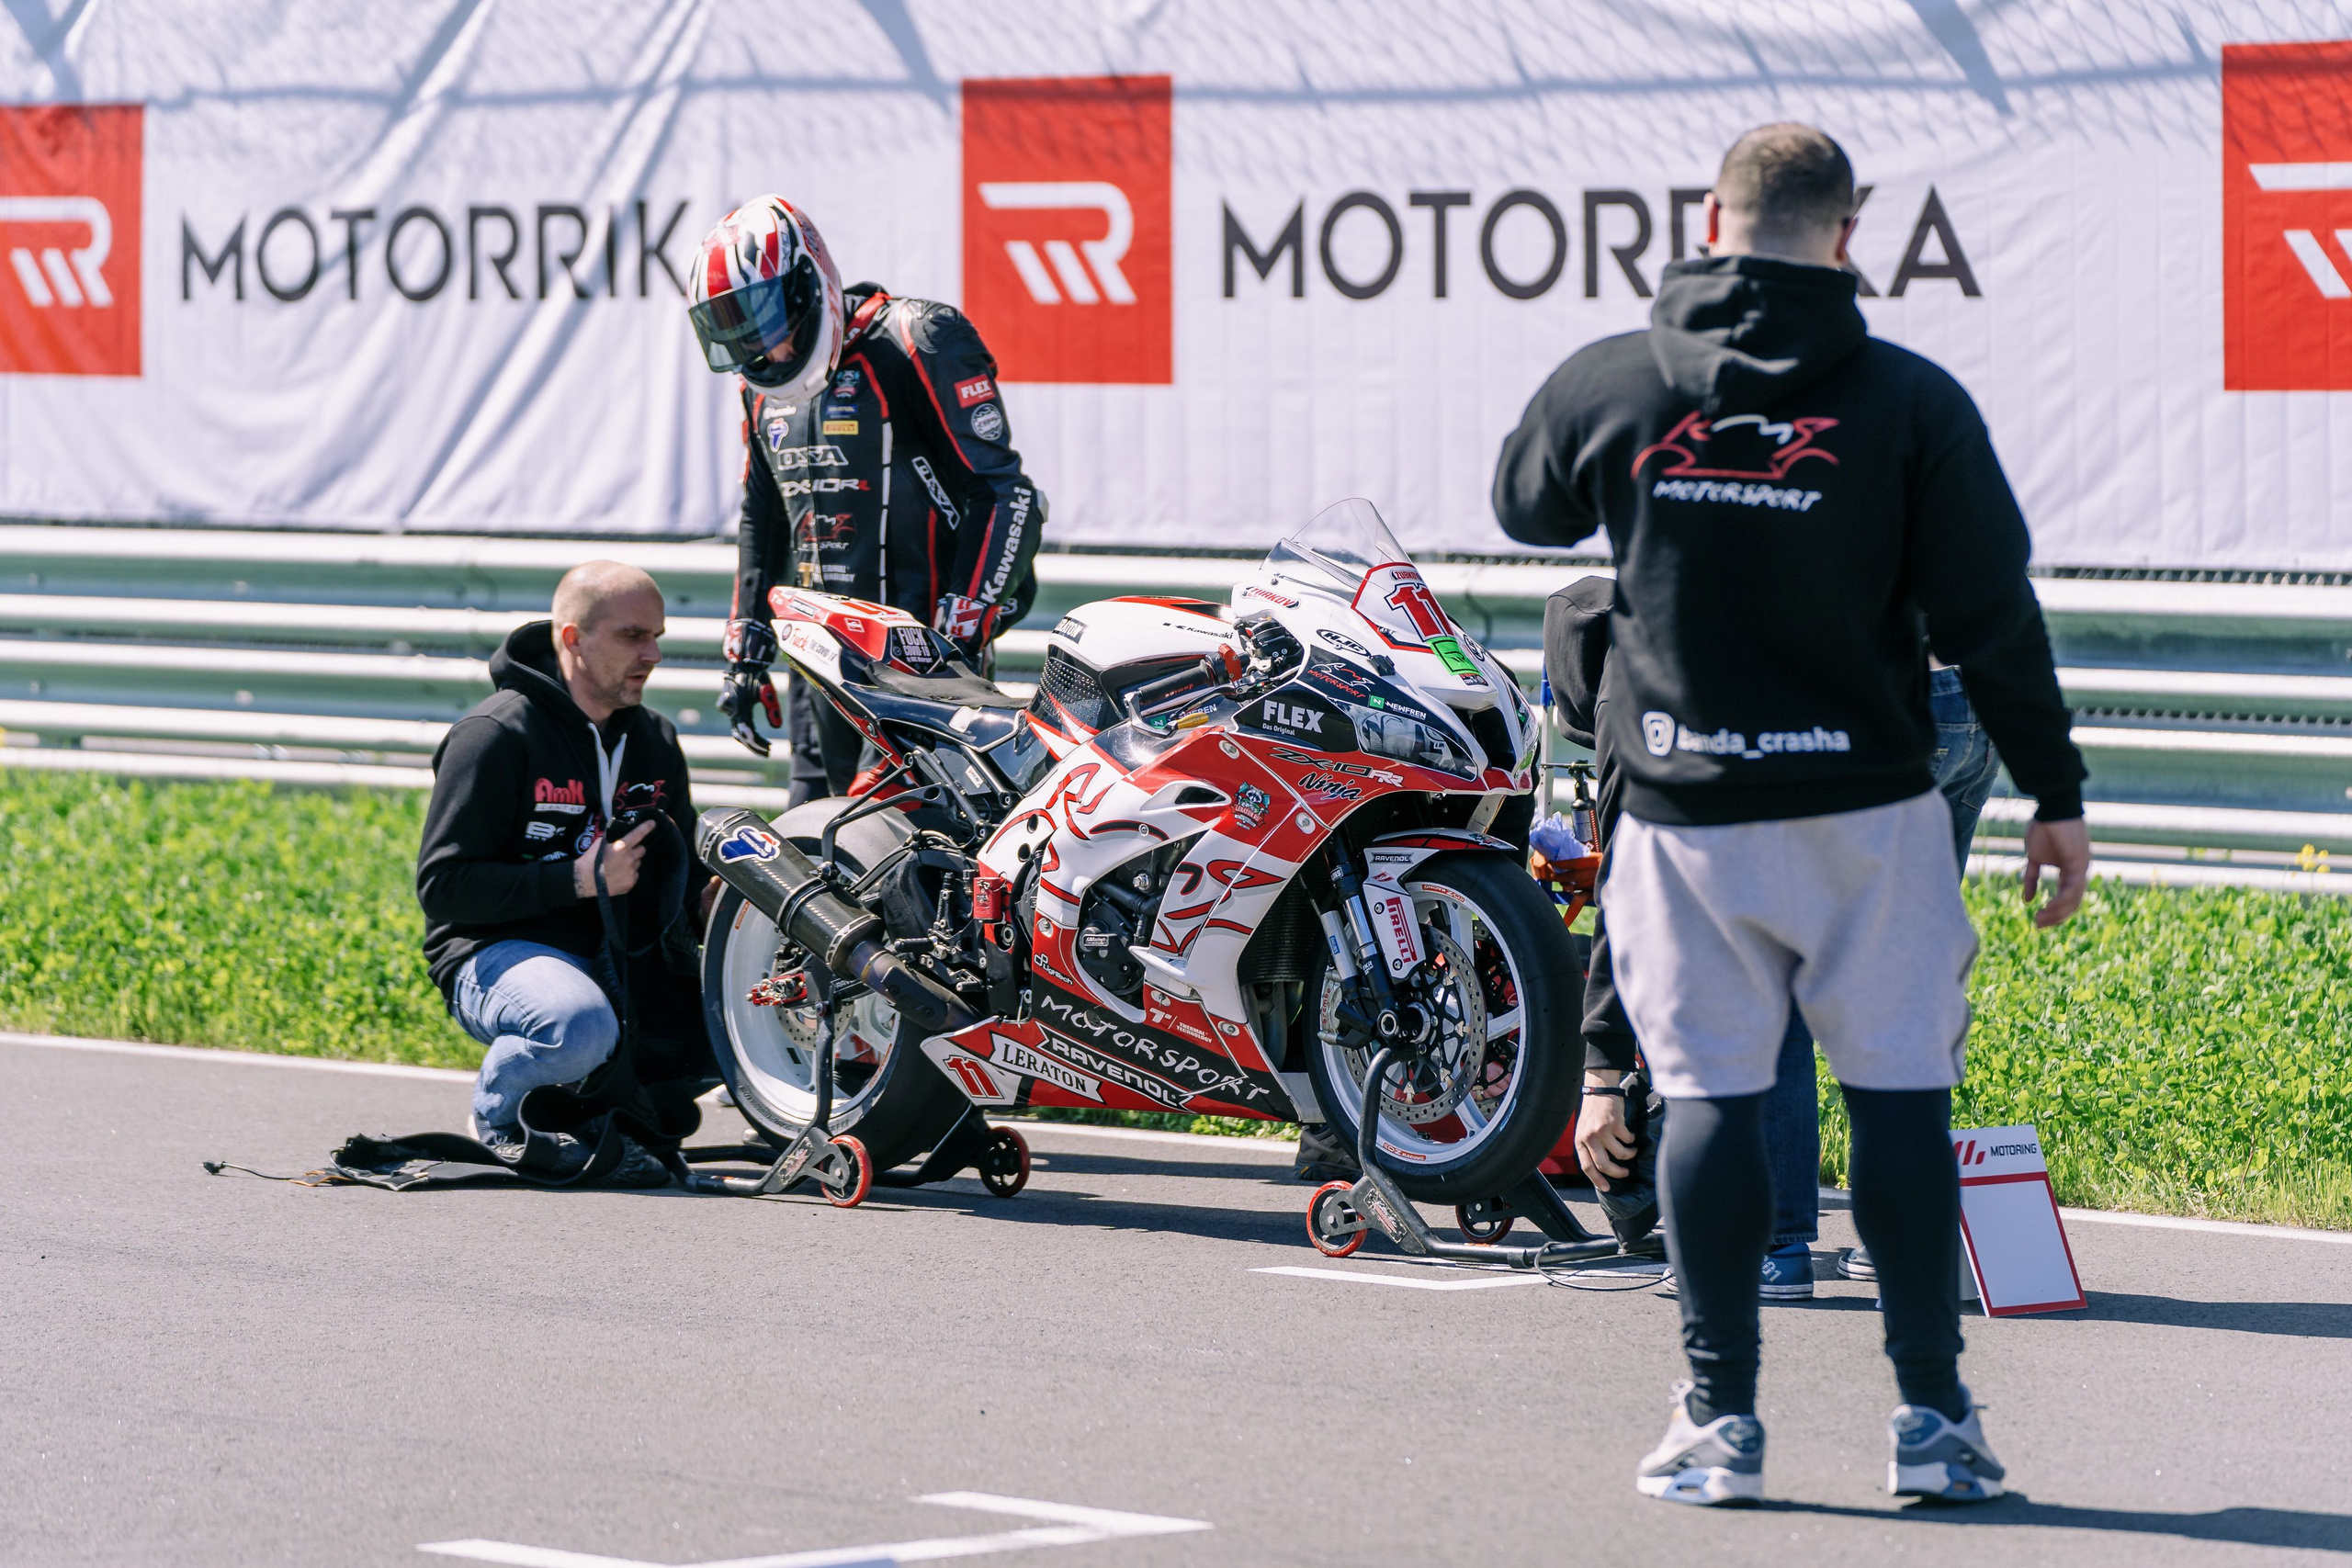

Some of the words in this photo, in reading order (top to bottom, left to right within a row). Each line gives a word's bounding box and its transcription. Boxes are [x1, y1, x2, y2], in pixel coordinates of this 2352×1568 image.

[179, 199, 741, 302] MOTORRIK
[1221, 186, 1983, 299] MOTORA
[960, 379, 991, 400] FLEX
[1653, 479, 1824, 513] MOTORSPORT
[980, 486, 1032, 604] Kawasaki
[1384, 582, 1455, 642] 11
[896, 626, 927, 646] FUCK
[1186, 626, 1234, 639] Kawasaki
[1323, 631, 1365, 653] HJC
[902, 645, 932, 657] COVID-19
[1306, 669, 1366, 698] MOTORSPORT
[1263, 699, 1325, 734] FLEX
[1385, 701, 1428, 718] NEWFREN
[1273, 725, 1295, 736] Original
[1298, 772, 1365, 802] Ninja
[1385, 896, 1418, 964] PIRELLI
[1322, 987, 1331, 1025] brembo
[1176, 1025, 1212, 1043] TECHNOLOGY
[1179, 1021, 1205, 1036] THERMAL
[1041, 995, 1270, 1100] MOTORSPORT
[944, 1055, 1004, 1100] 11
[1002, 1043, 1086, 1093] LERATON
[1051, 1036, 1180, 1106] RAVENOL
[1402, 1152, 1424, 1160] RACING
[1990, 1143, 2037, 1156] MOTORING
